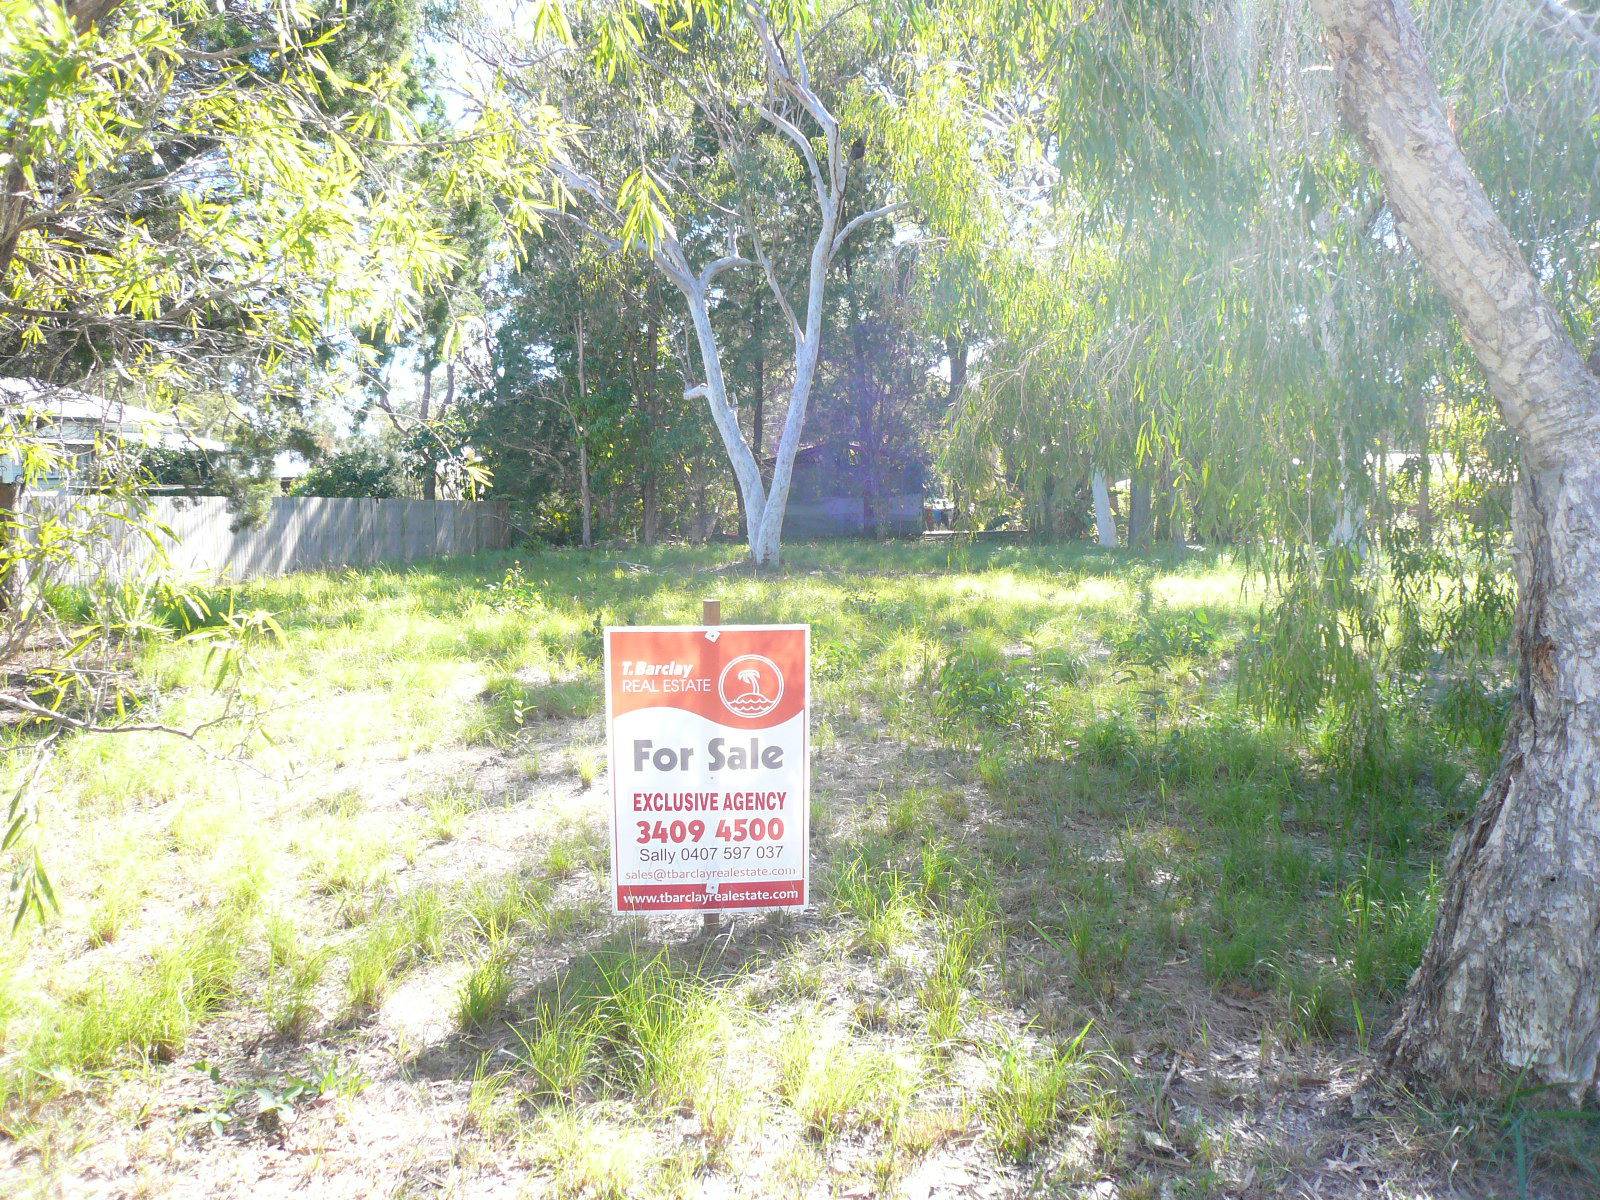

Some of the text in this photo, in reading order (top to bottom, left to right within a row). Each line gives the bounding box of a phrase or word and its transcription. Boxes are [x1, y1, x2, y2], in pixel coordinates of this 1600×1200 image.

[622, 678, 712, 693] REAL ESTATE
[633, 737, 784, 772] For Sale
[633, 791, 787, 812] EXCLUSIVE AGENCY
[636, 818, 785, 844] 3409 4500
[639, 845, 783, 864] Sally 0407 597 037
[625, 867, 796, 882] sales@tbarclayrealestate.com
[623, 888, 799, 905] www.tbarclayrealestate.com
